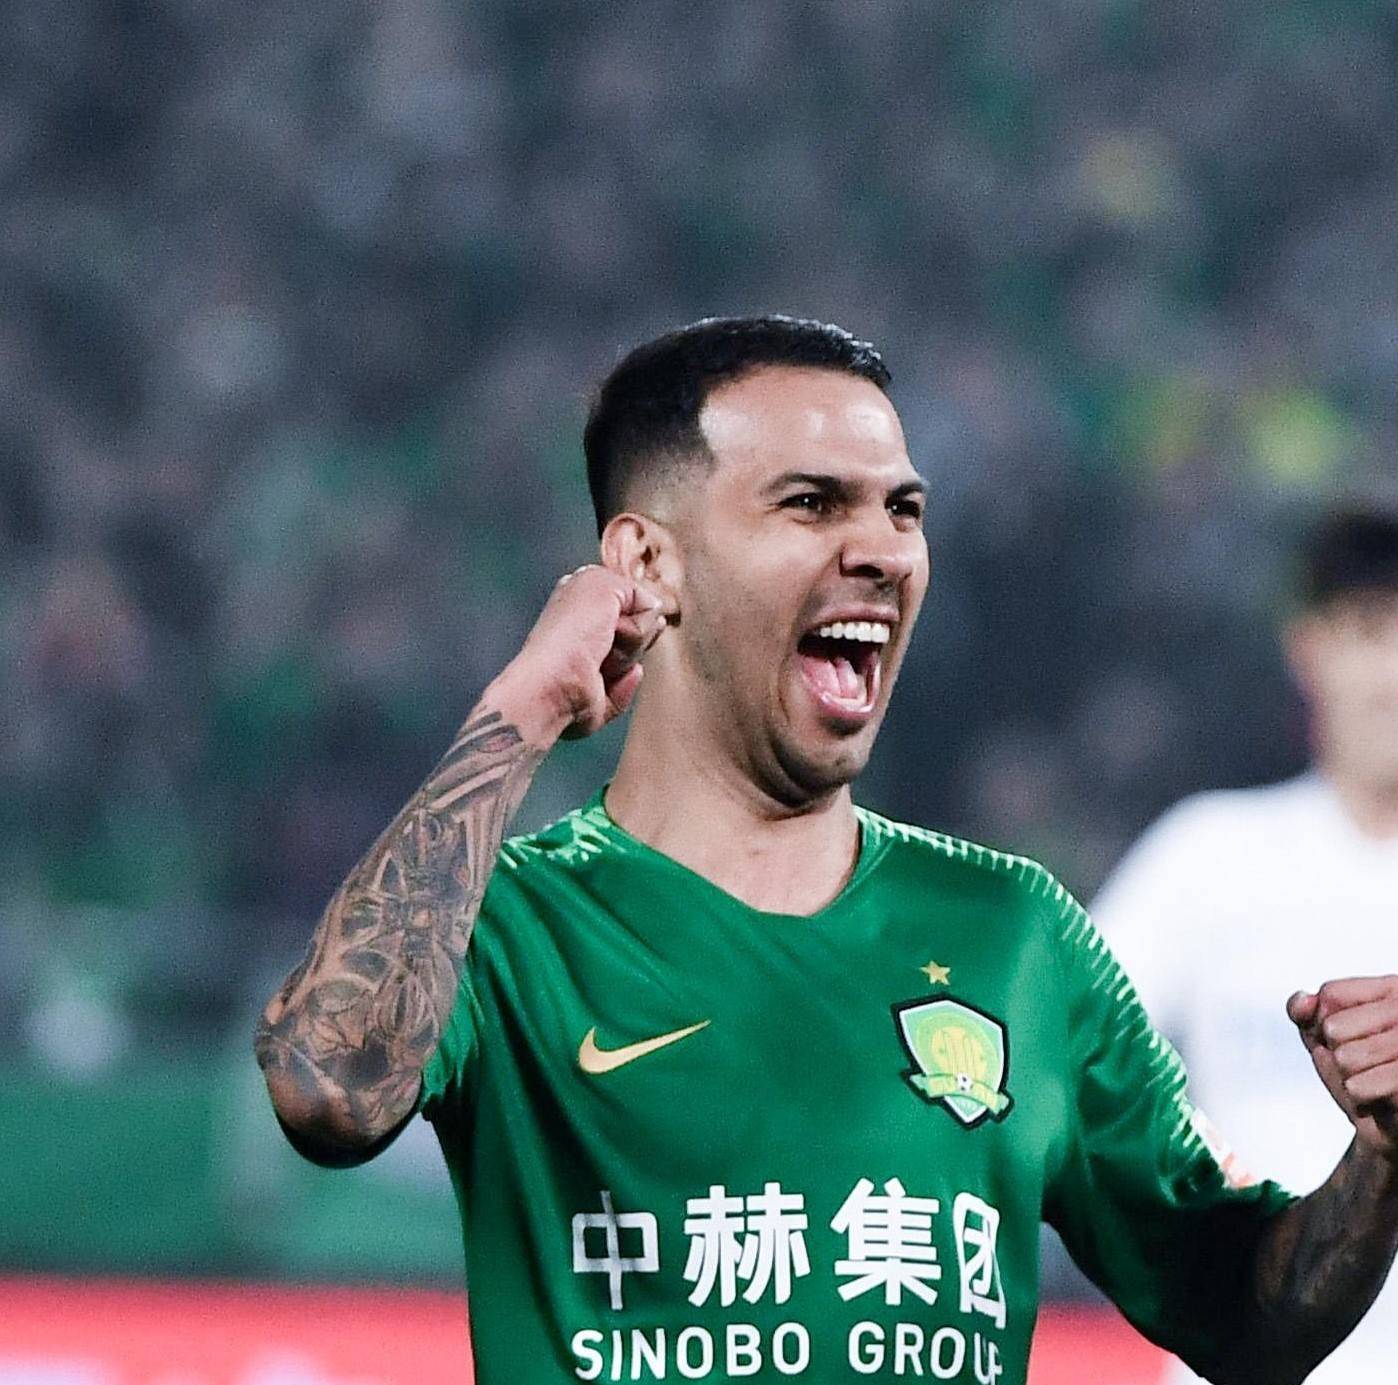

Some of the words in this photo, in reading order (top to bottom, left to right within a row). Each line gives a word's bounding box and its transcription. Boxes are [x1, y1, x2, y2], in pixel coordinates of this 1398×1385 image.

[572, 1177, 1007, 1330] 中赫集团
[572, 1322, 810, 1381] SINOBO
